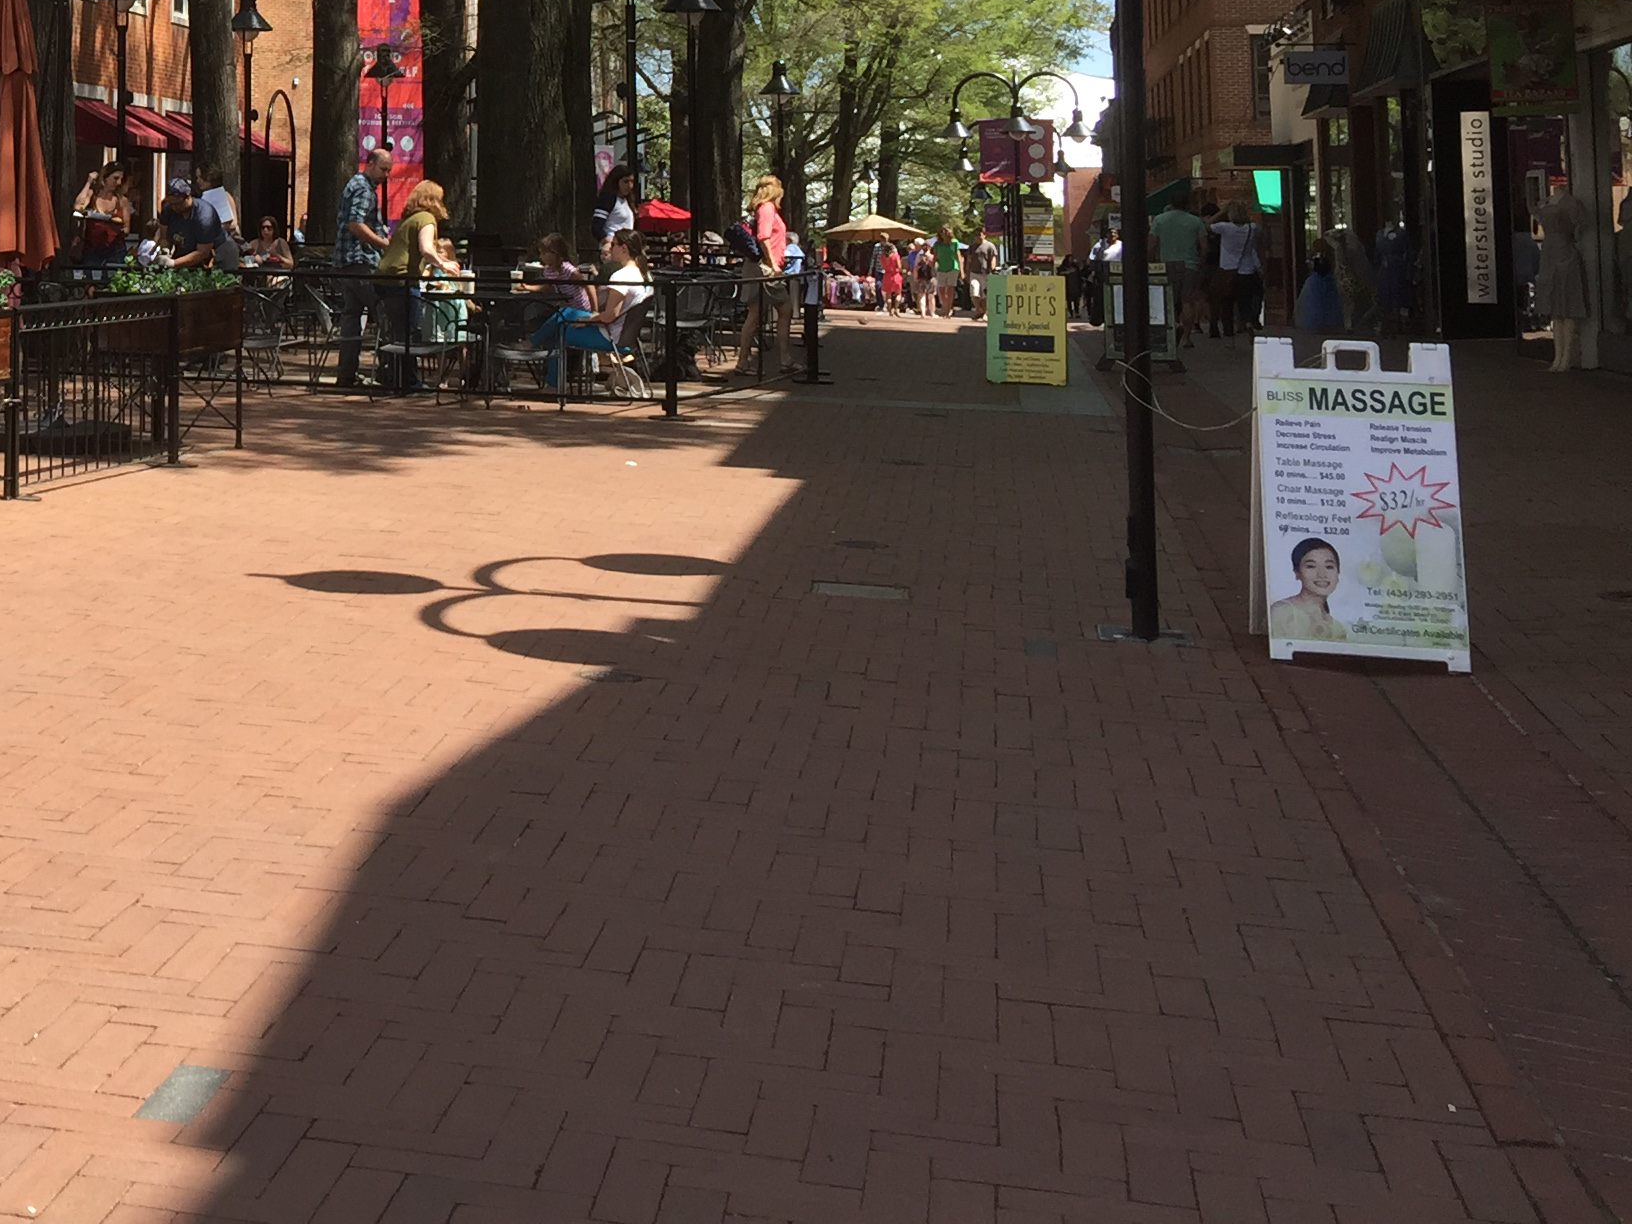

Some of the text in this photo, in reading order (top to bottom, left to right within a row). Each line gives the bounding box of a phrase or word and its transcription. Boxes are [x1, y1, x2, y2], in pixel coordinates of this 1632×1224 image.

[1287, 57, 1345, 76] bend
[1466, 118, 1490, 298] waterstreet studio
[996, 294, 1057, 316] EPPIE'S
[1267, 387, 1447, 416] BLISS MASSAGE
[1305, 420, 1321, 428] Pain
[1402, 424, 1432, 433] Tension
[1312, 431, 1336, 440] Stress
[1310, 443, 1350, 452] Circulation
[1371, 446, 1401, 455] Improve
[1276, 457, 1343, 470] Table Massage
[1277, 484, 1344, 497] Chair Massage
[1275, 511, 1328, 524] Reflexology
